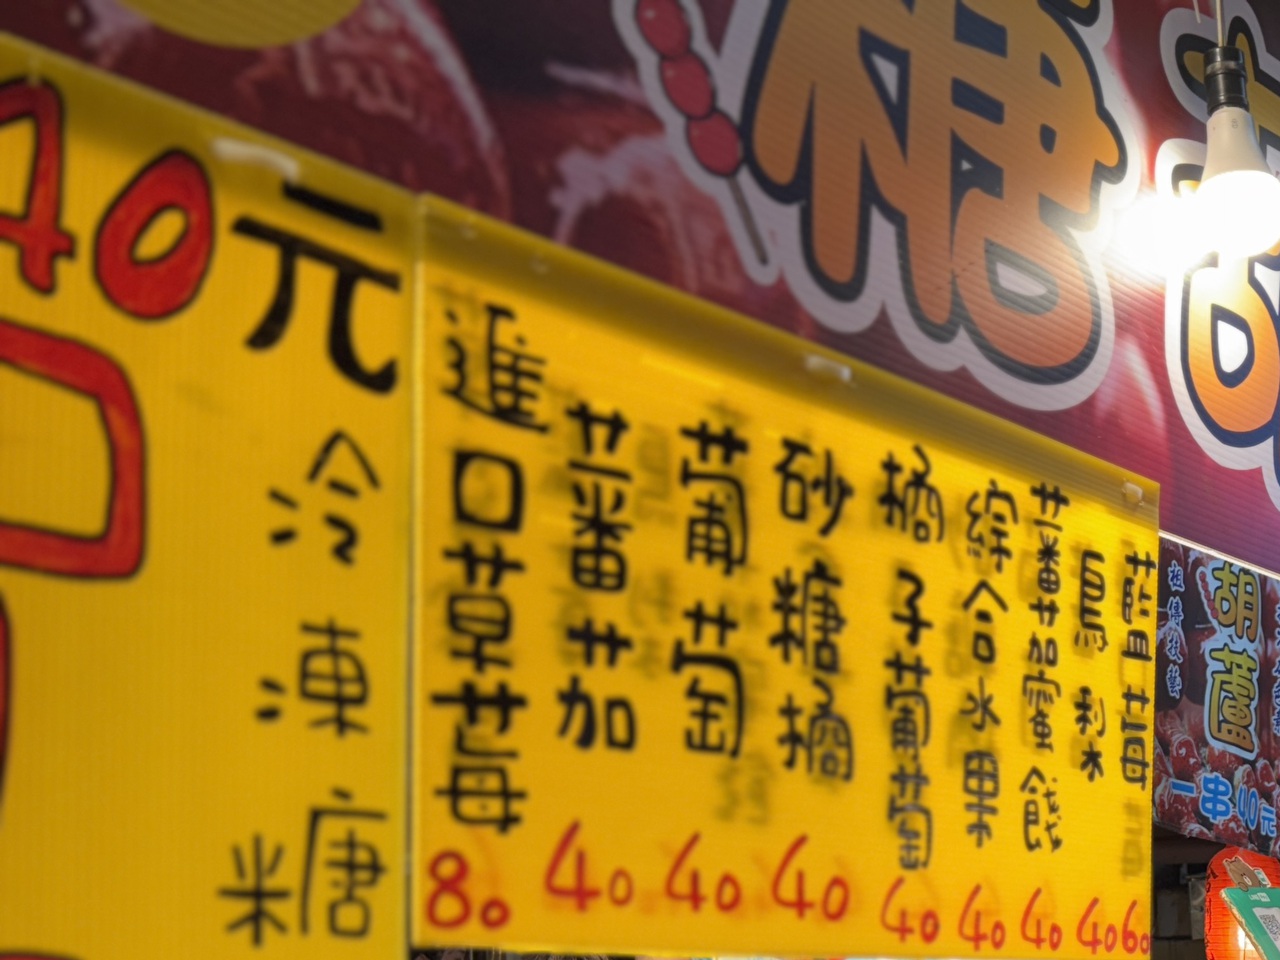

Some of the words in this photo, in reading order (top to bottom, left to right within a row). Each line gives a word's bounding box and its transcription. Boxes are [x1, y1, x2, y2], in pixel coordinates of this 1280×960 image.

[671, 419, 751, 759] 葡萄
[771, 437, 854, 784] 砂糖橘
[1167, 560, 1186, 699] 祖傳技藝
[878, 444, 945, 871] 橘子葡萄
[960, 479, 1020, 850] 綜合水果
[425, 850, 512, 931] 80
[543, 820, 636, 914] 40
[664, 831, 743, 914] 40
[770, 833, 851, 922] 40
[880, 876, 941, 945] 40
[957, 882, 1006, 951] 40
[1019, 886, 1064, 951] 40
[1076, 896, 1118, 955] 40
[1120, 899, 1152, 955] 60
